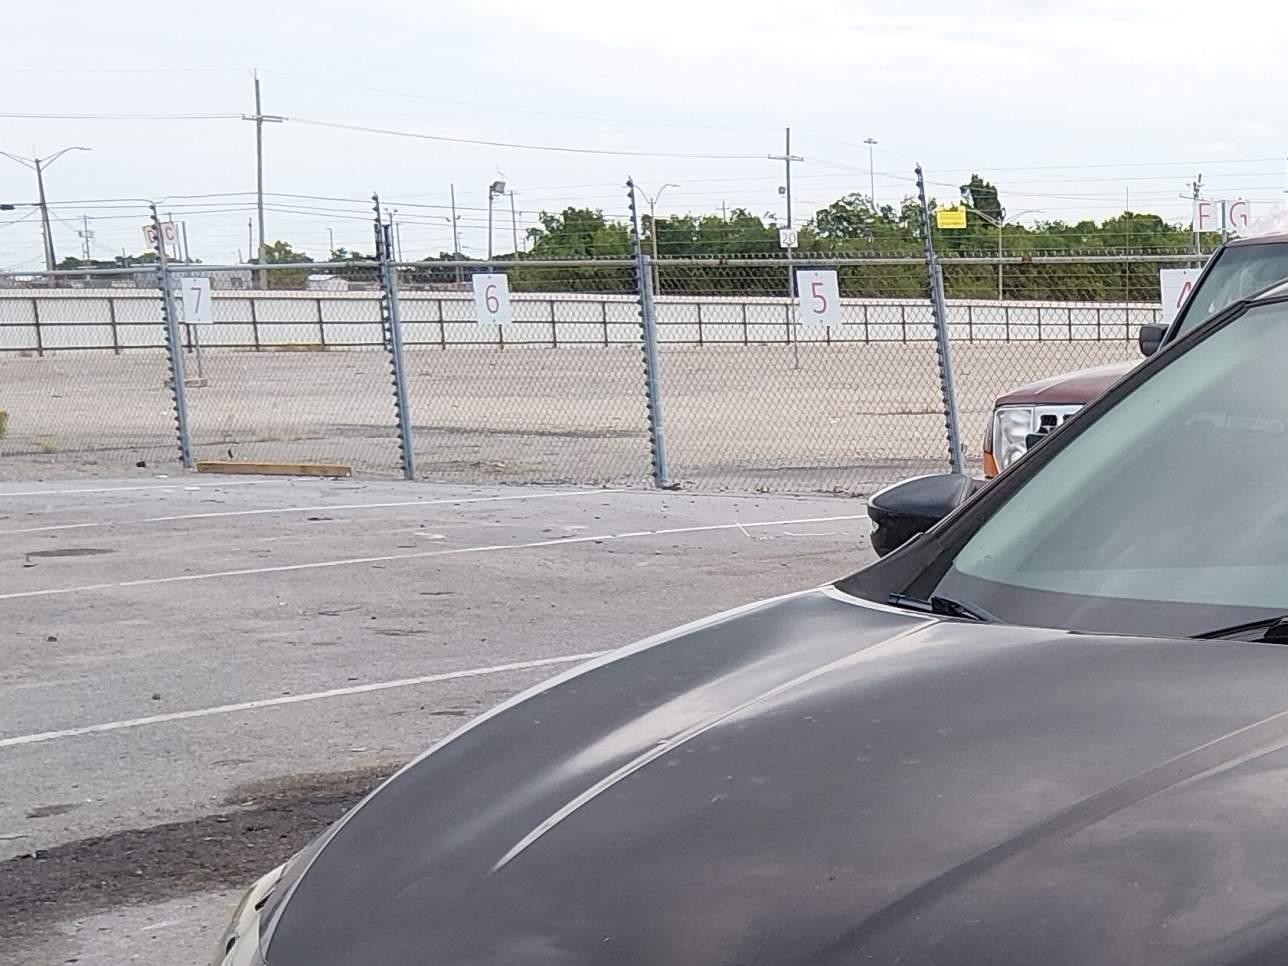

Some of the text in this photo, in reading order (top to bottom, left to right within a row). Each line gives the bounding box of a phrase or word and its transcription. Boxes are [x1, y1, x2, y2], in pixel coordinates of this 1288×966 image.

[1198, 202, 1212, 230] F
[1229, 201, 1248, 228] G
[165, 226, 175, 241] C
[190, 286, 202, 314] 7
[485, 284, 500, 314] 6
[811, 282, 827, 315] 5
